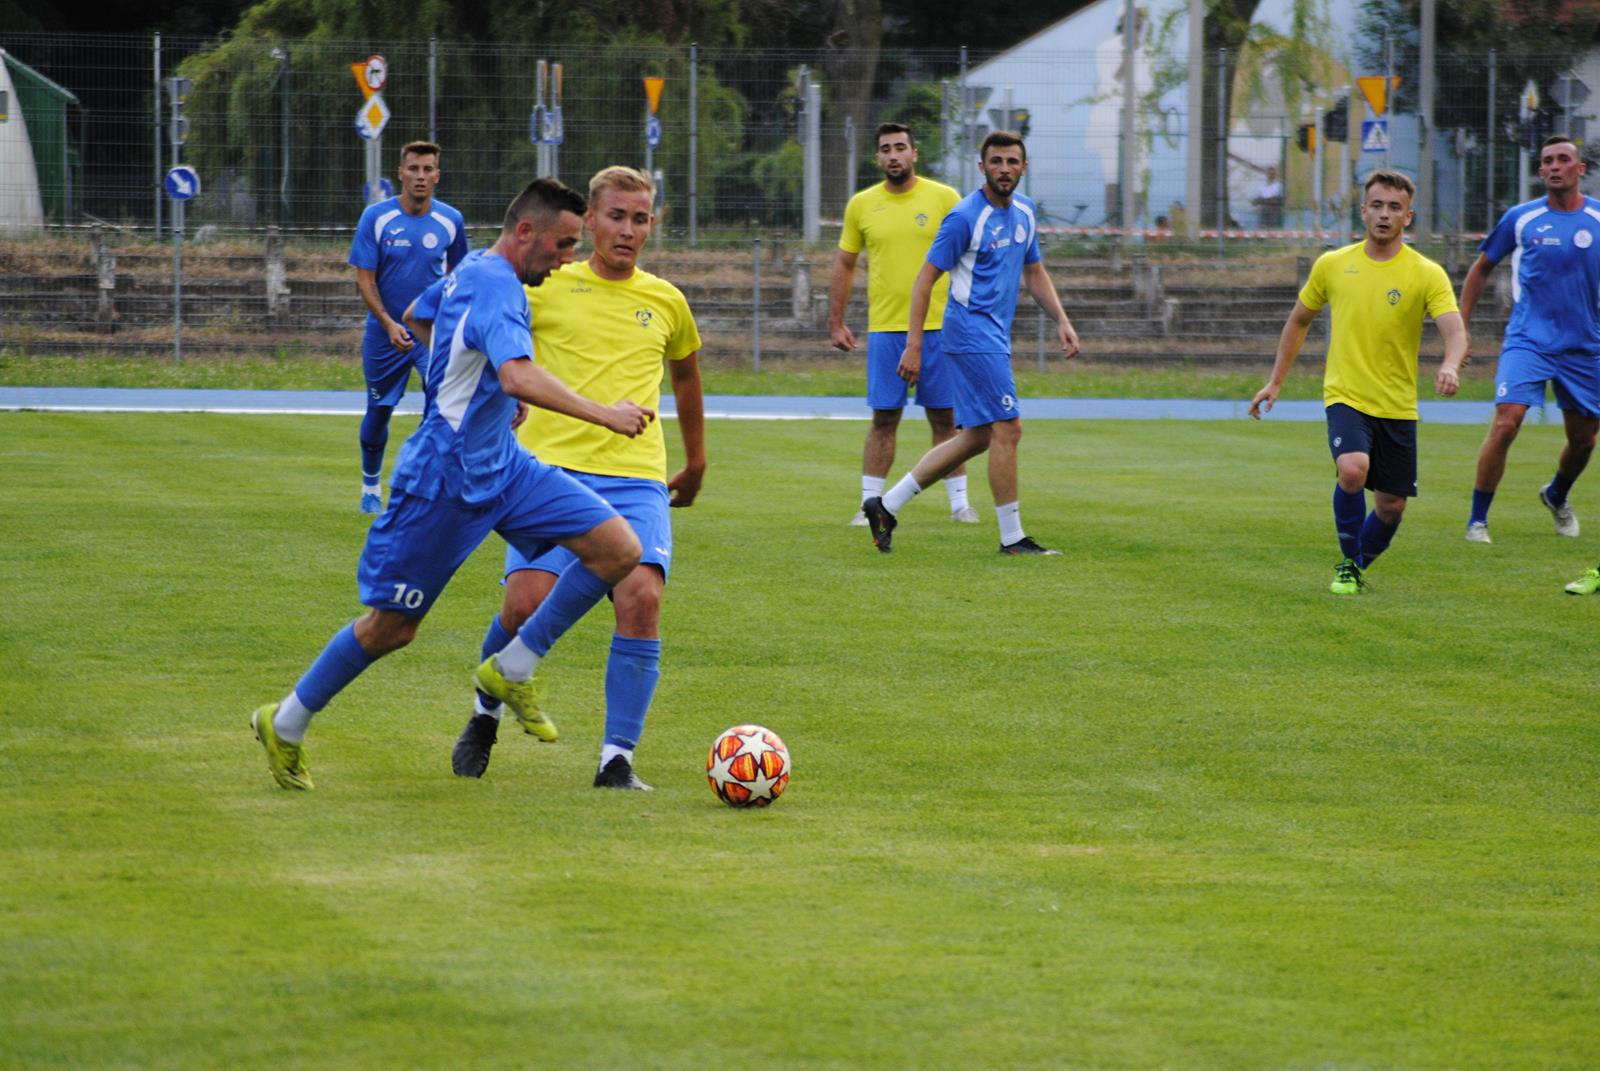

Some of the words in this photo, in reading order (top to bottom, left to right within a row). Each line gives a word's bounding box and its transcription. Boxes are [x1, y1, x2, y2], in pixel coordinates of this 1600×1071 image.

[1497, 382, 1507, 396] 6
[1001, 395, 1014, 411] 9
[391, 583, 424, 609] 10
